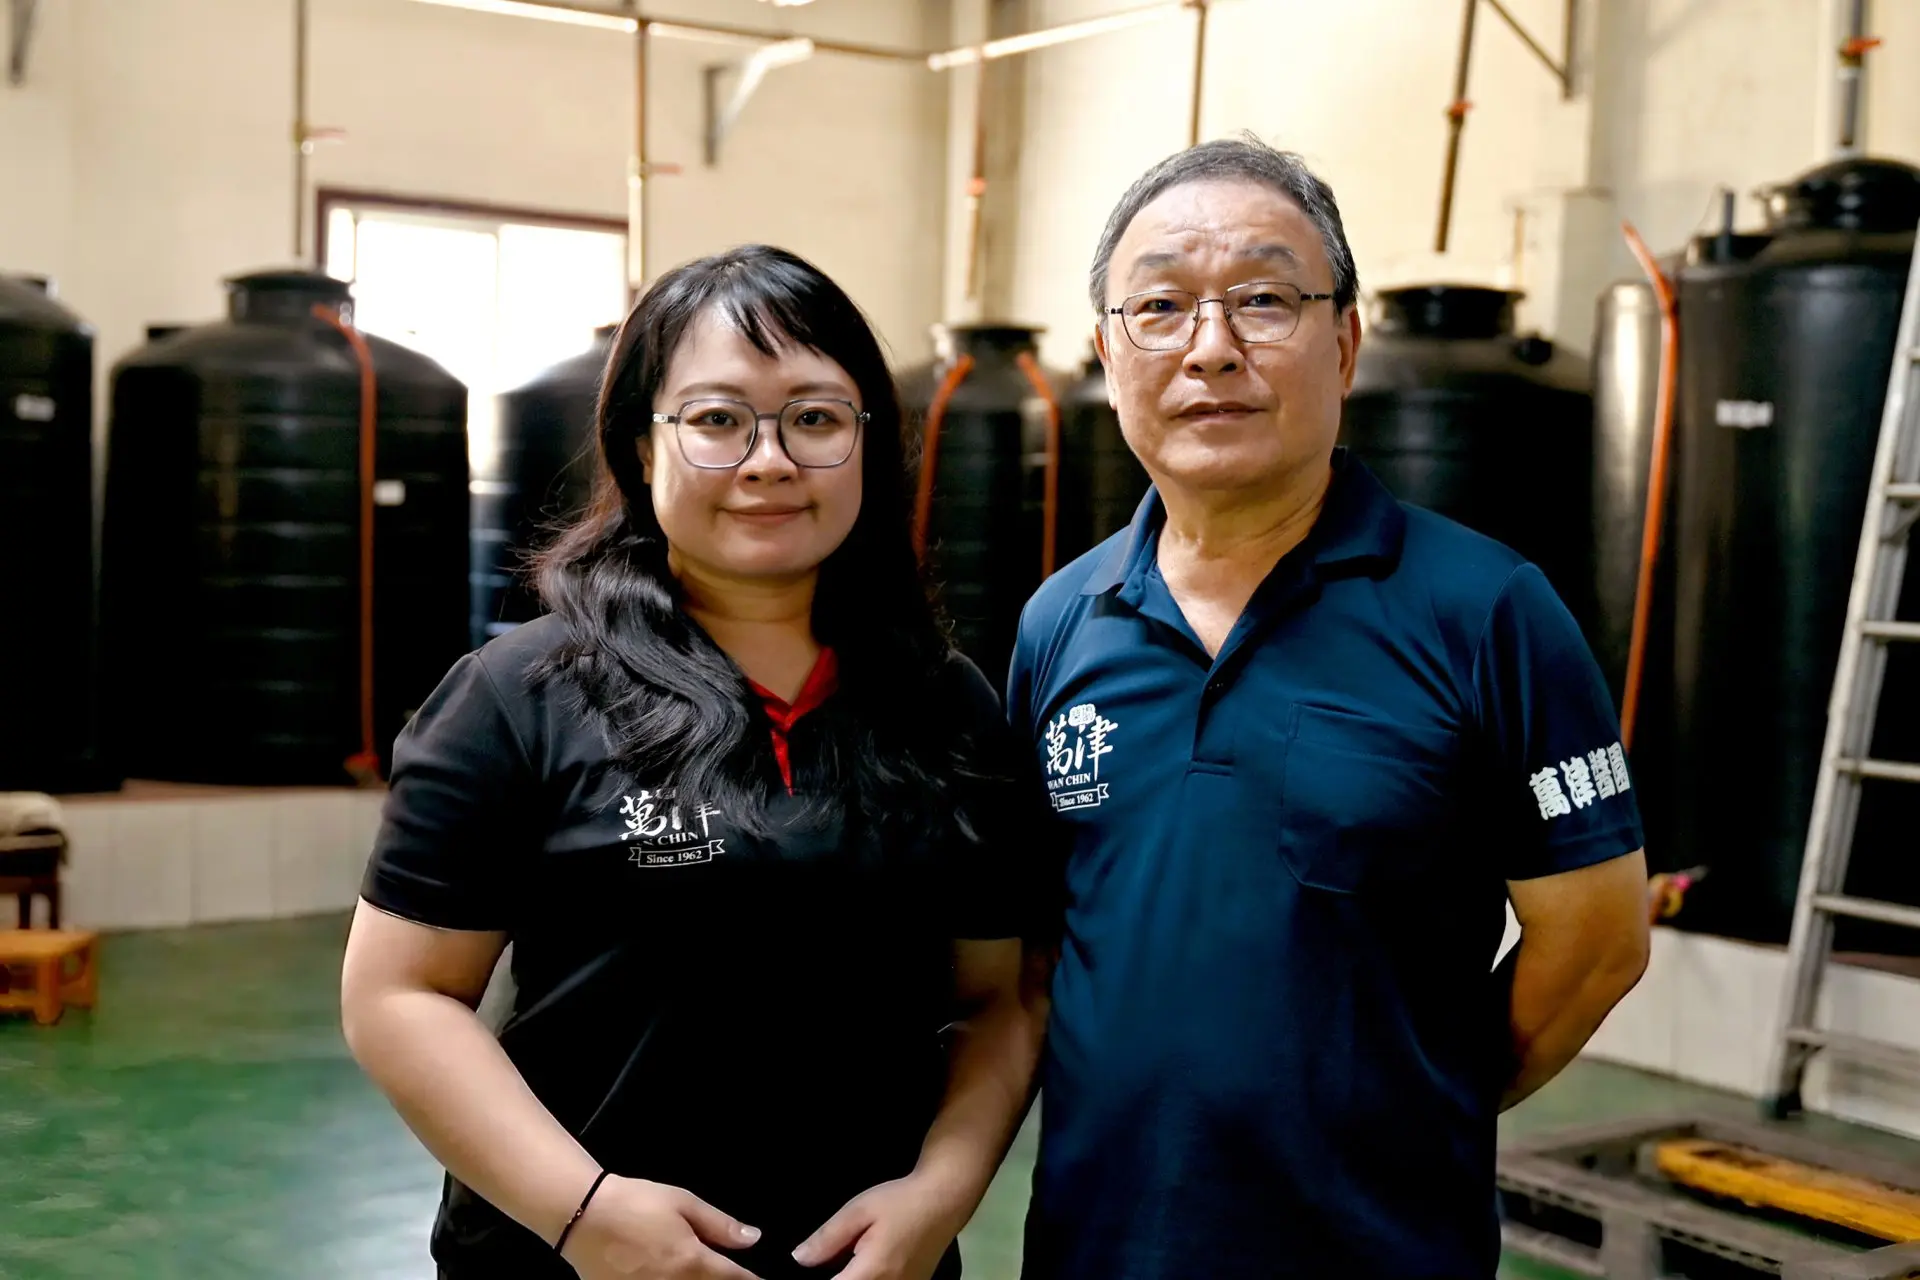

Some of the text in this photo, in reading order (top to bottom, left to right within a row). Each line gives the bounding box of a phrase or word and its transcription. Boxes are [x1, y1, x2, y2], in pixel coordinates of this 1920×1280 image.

[1065, 773, 1091, 786] CHIN
[1059, 793, 1094, 807] Since 1962
[657, 831, 699, 846] CHIN
[646, 850, 703, 864] Since 1962
